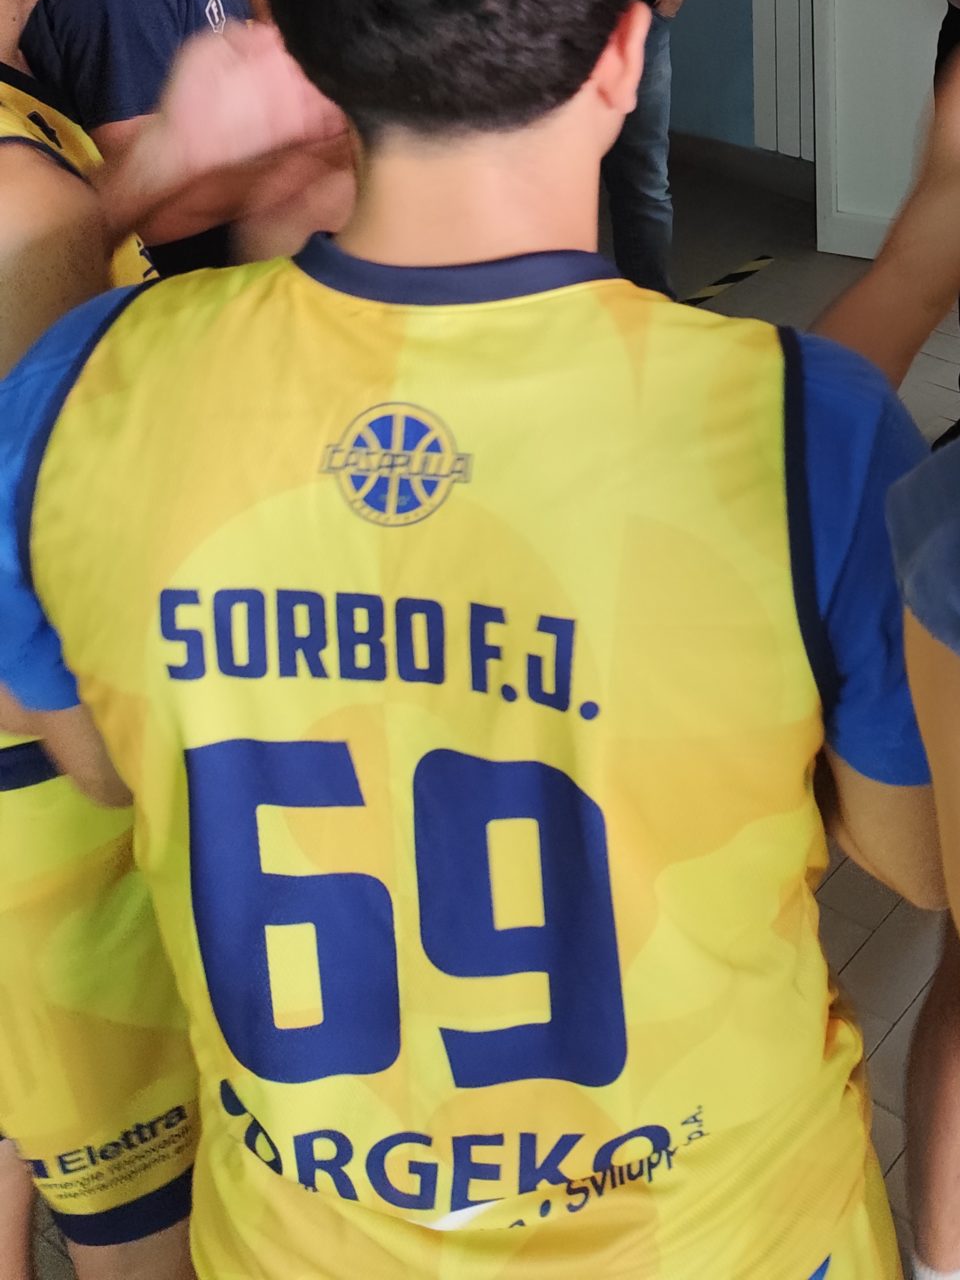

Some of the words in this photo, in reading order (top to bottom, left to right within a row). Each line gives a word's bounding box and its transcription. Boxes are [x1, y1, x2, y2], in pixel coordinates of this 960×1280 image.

[159, 589, 445, 685] SORBO
[470, 602, 600, 721] F.J.
[183, 738, 628, 1089] 69
